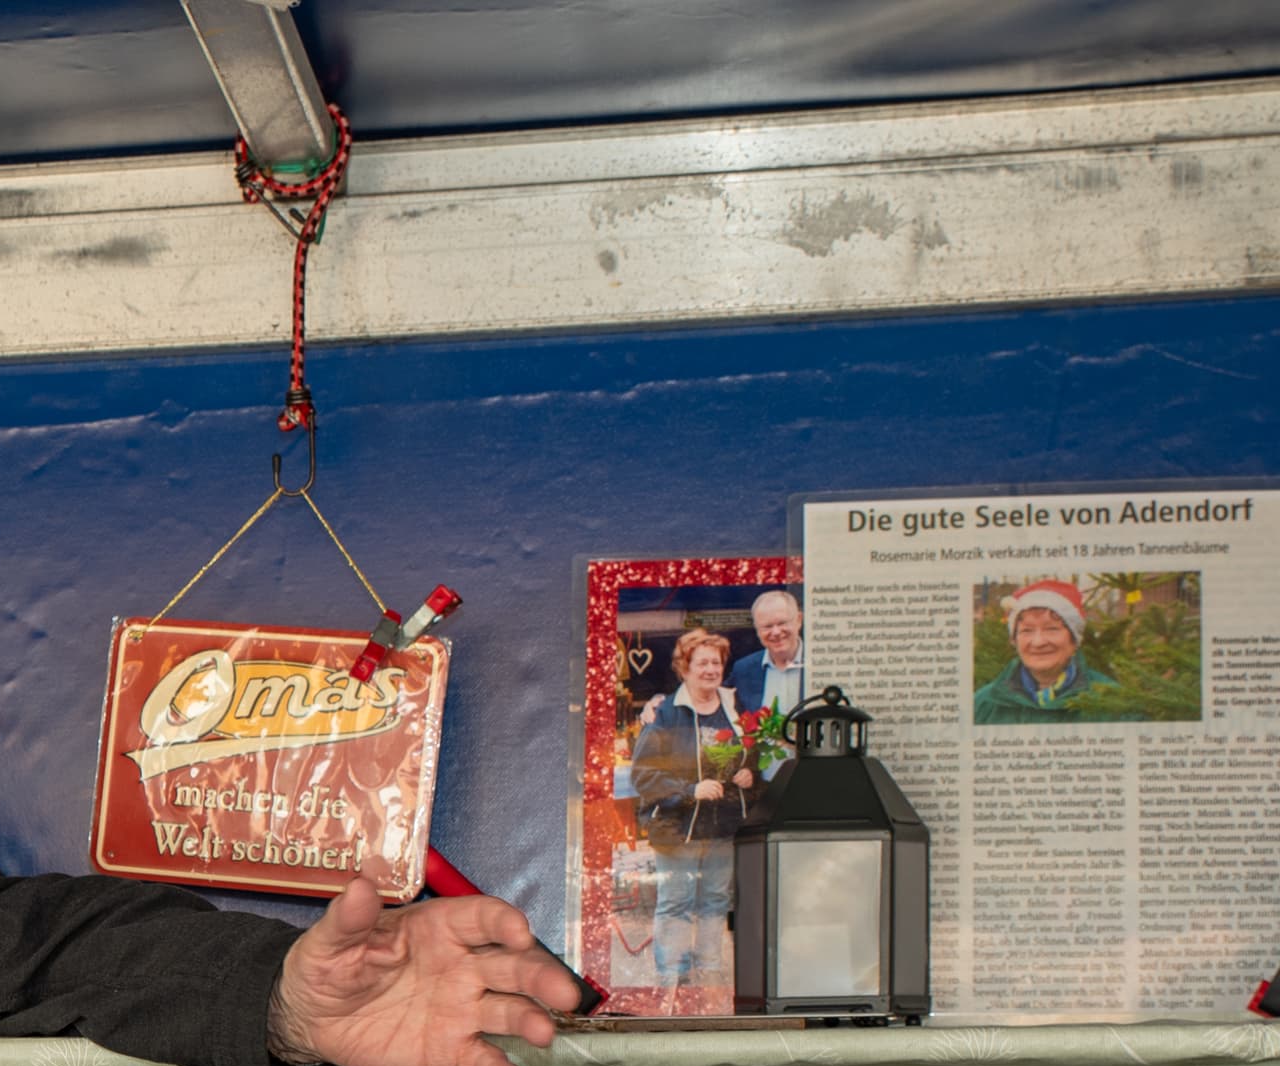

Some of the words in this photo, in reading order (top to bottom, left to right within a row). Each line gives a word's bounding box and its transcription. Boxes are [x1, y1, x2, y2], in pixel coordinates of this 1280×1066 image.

[847, 508, 892, 533] Die
[903, 506, 965, 537] gute
[975, 503, 1051, 529] Seele
[1060, 506, 1112, 525] von
[1120, 498, 1254, 524] Adendorf
[870, 548, 937, 563] Rosemarie
[939, 547, 985, 561] Morzik
[988, 545, 1042, 559] verkauft
[1045, 544, 1069, 558] seit
[1072, 545, 1088, 557] 18
[1091, 542, 1135, 557] Jahren
[1137, 540, 1230, 556] Tannenbäume
[140, 648, 407, 741] Omas
[175, 779, 289, 818] machen
[299, 784, 348, 820] die
[152, 820, 224, 859] Welt
[232, 831, 368, 873] schöner!
